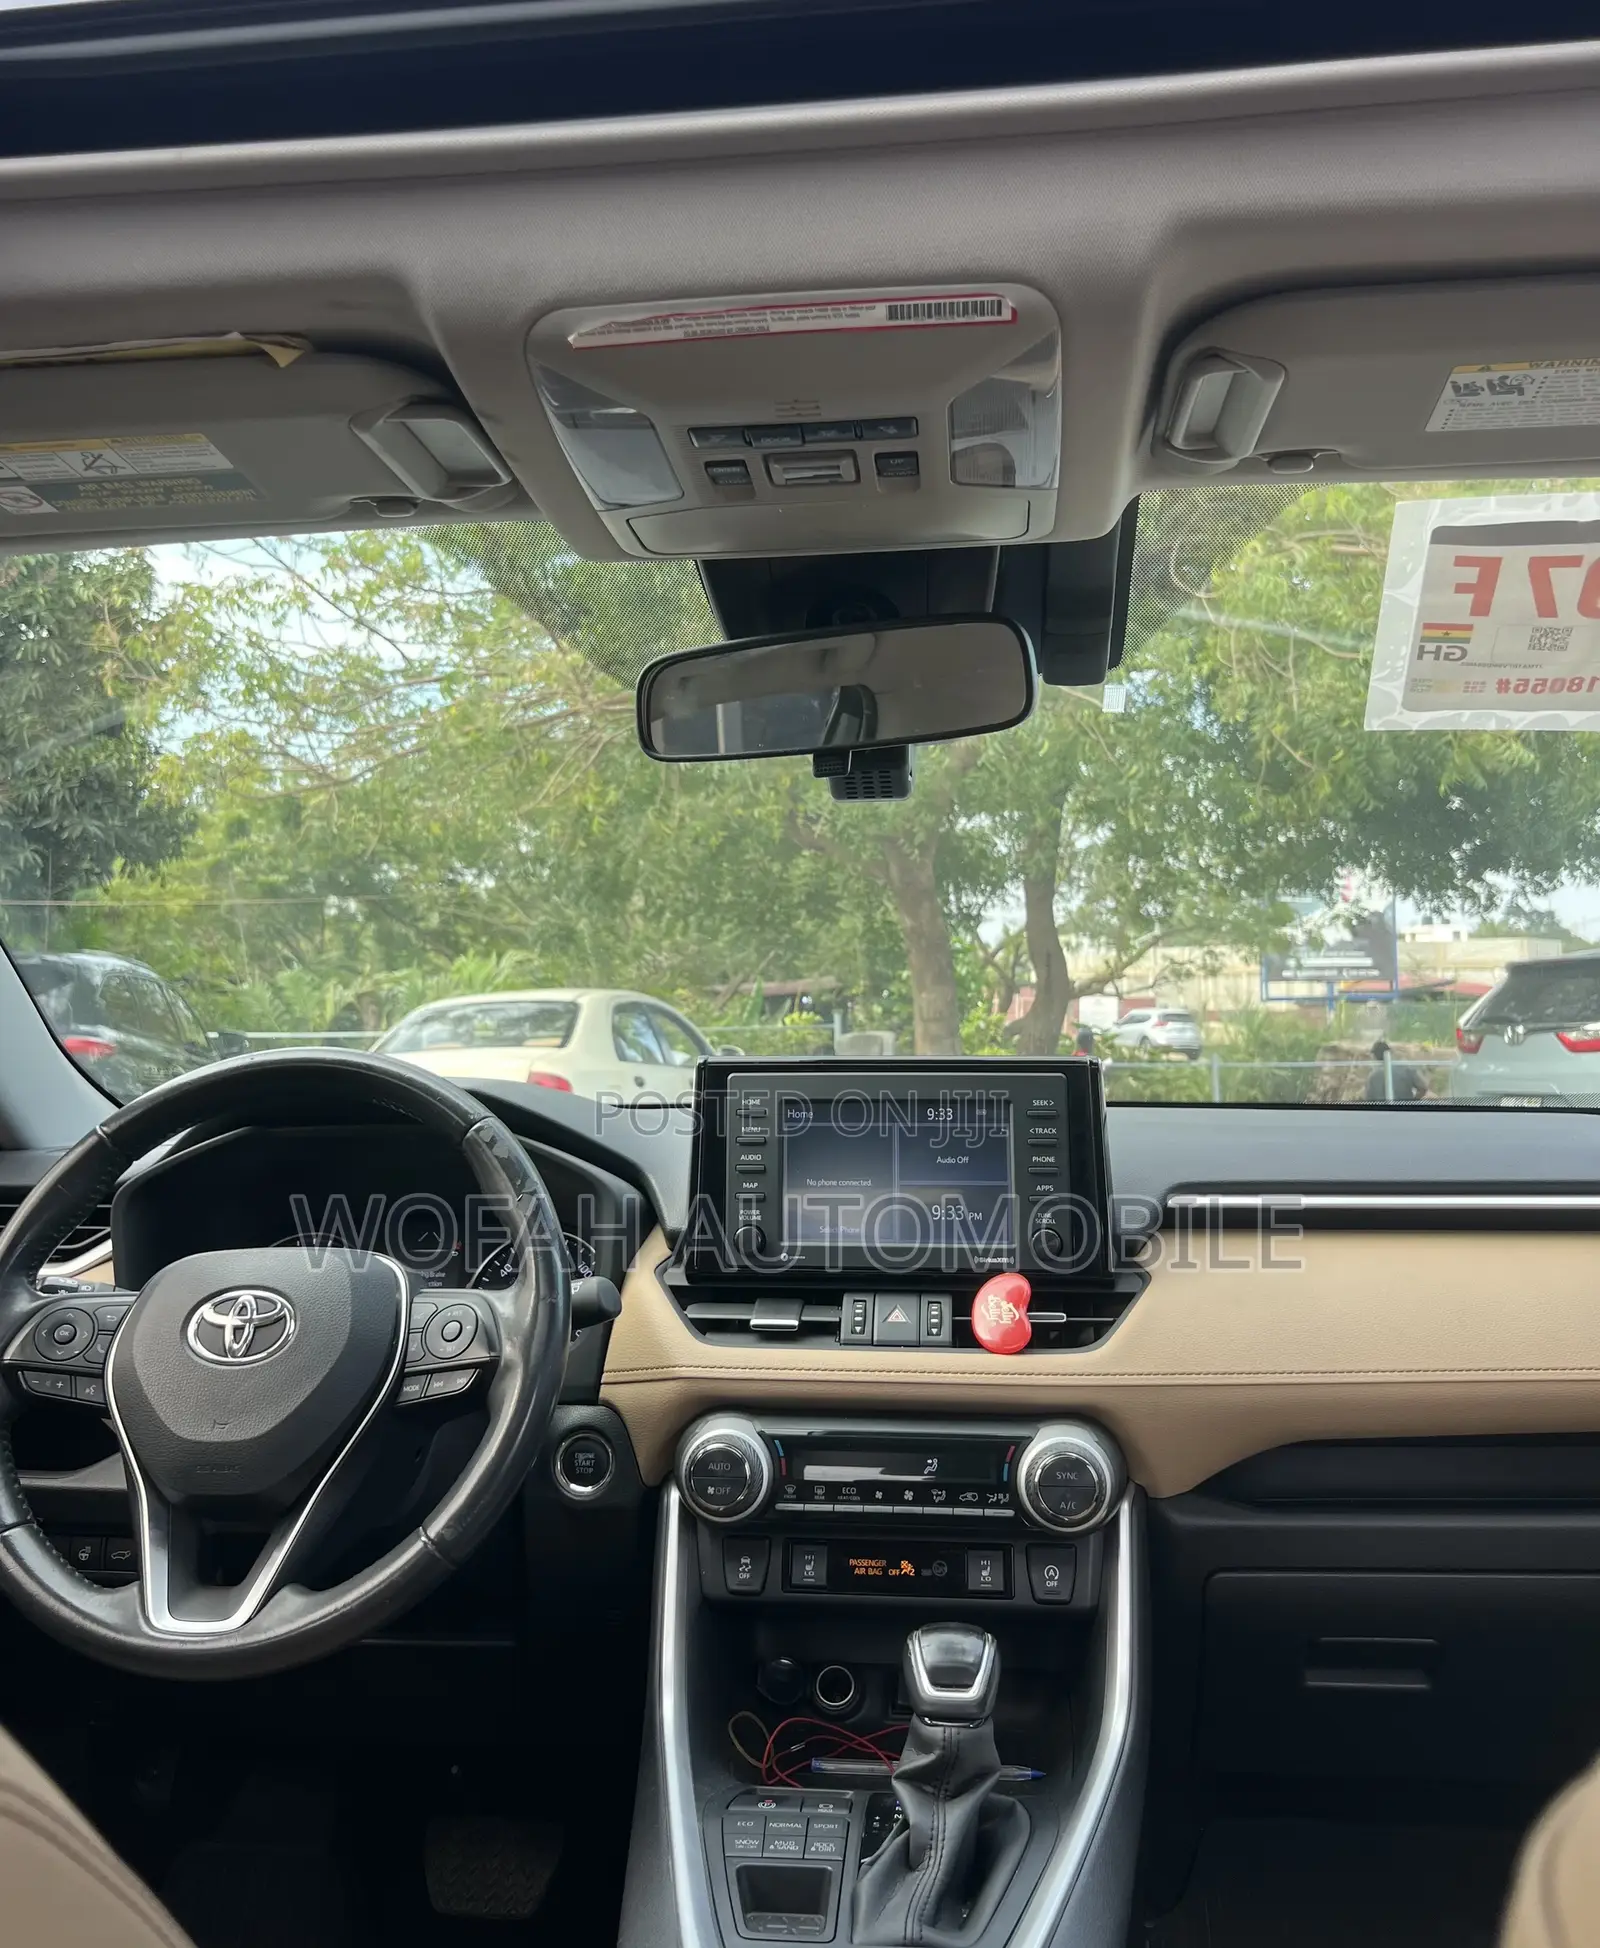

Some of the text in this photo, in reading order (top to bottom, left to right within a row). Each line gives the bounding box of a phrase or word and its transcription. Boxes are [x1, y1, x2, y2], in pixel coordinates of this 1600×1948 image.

[787, 1108, 954, 1121] Home 9:33
[936, 1155, 969, 1164] Audio Off
[1032, 1155, 1056, 1163] PHONE
[806, 1178, 817, 1186] No
[818, 1178, 838, 1188] phone
[1036, 1184, 1054, 1192] APPS
[931, 1204, 983, 1221] 9:33 PM
[499, 1263, 513, 1278] 40
[577, 1261, 593, 1278] 100
[999, 1299, 1020, 1325] Jelly
[403, 1384, 420, 1392] MODE
[708, 1462, 731, 1471] AUTO
[1056, 1471, 1079, 1480] SYNC
[715, 1486, 732, 1495] OFF
[841, 1487, 857, 1495] ECO
[1059, 1501, 1077, 1510] A/C
[849, 1558, 887, 1567] PASSENGER
[854, 1567, 866, 1576] AIR
[867, 1567, 883, 1576] BAG
